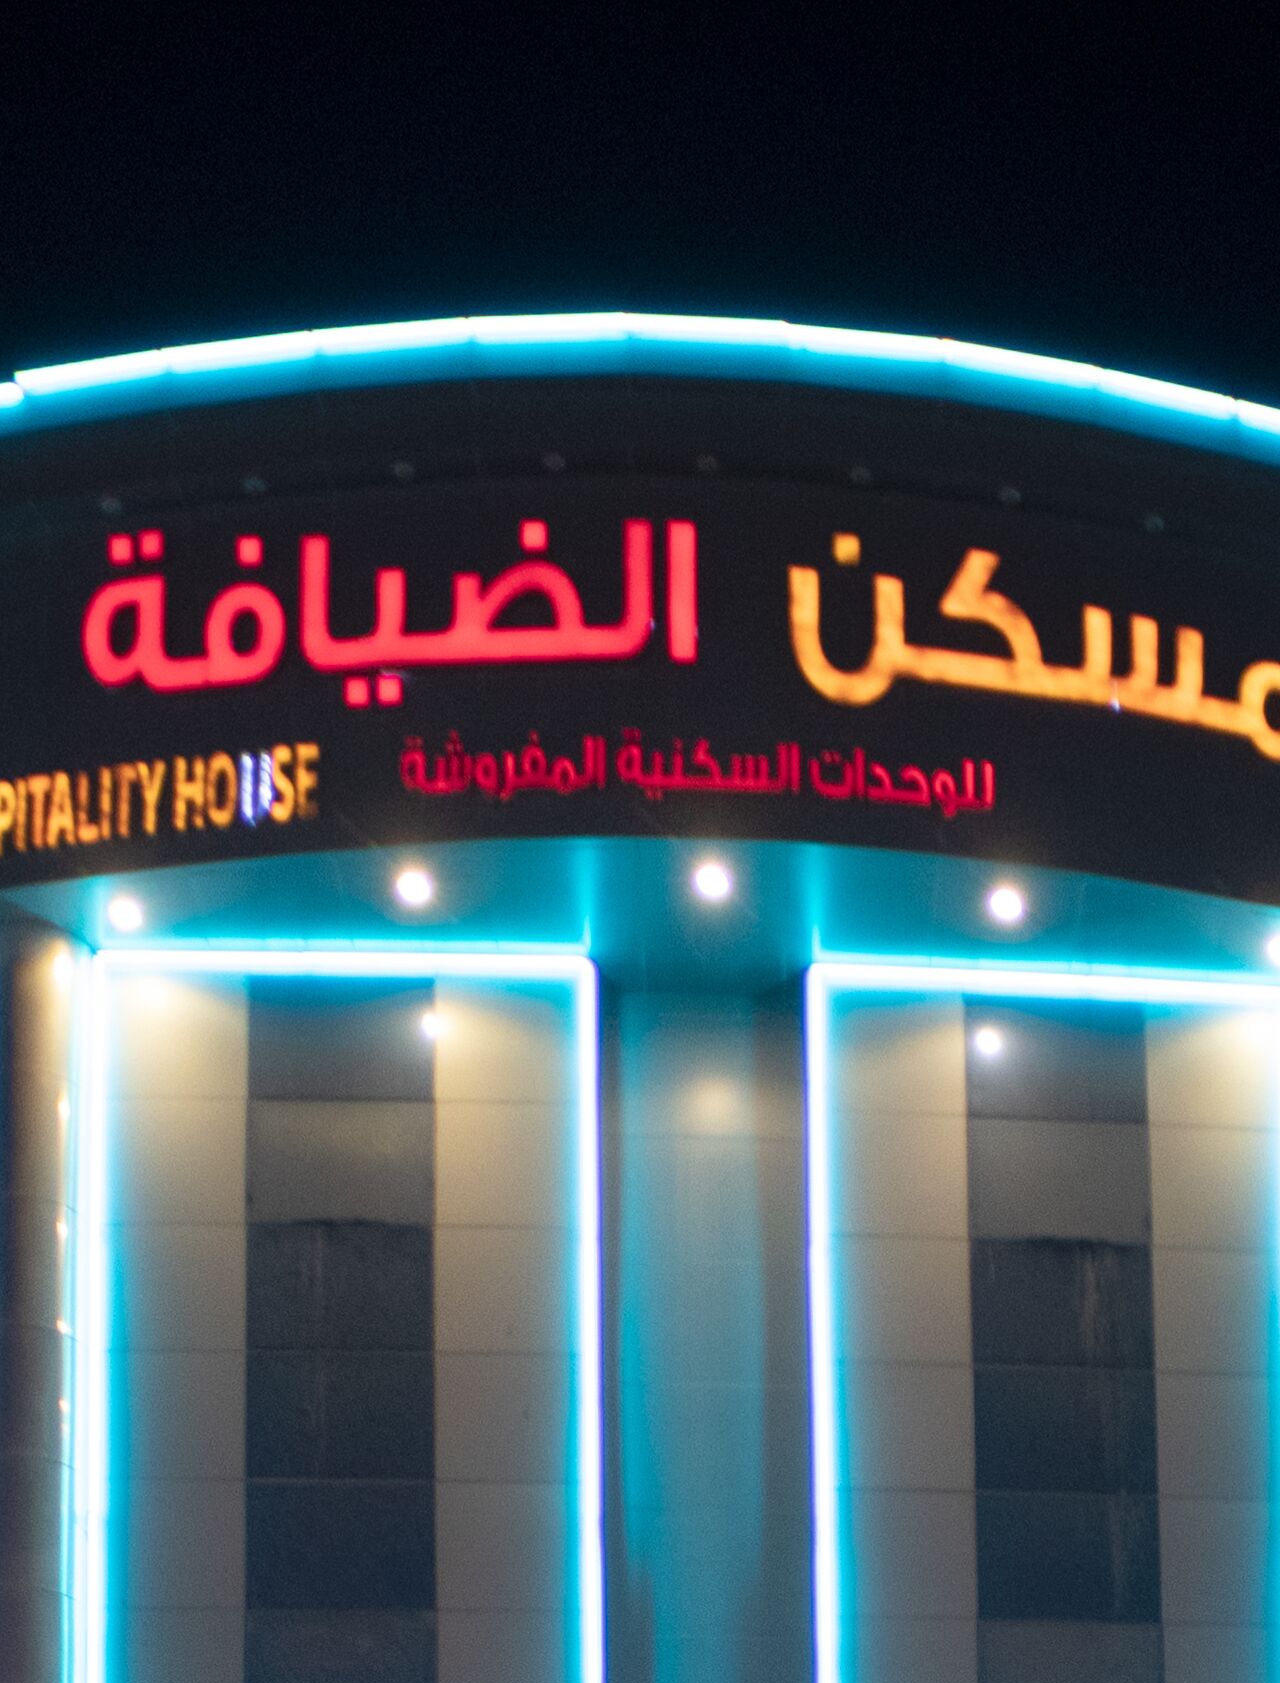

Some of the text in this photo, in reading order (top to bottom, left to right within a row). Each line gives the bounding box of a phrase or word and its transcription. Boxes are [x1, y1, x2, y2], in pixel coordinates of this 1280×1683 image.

[80, 518, 699, 709] الضيافة
[172, 740, 320, 832] HOUSE
[399, 727, 996, 818] للوحدات السكنية المفروشة
